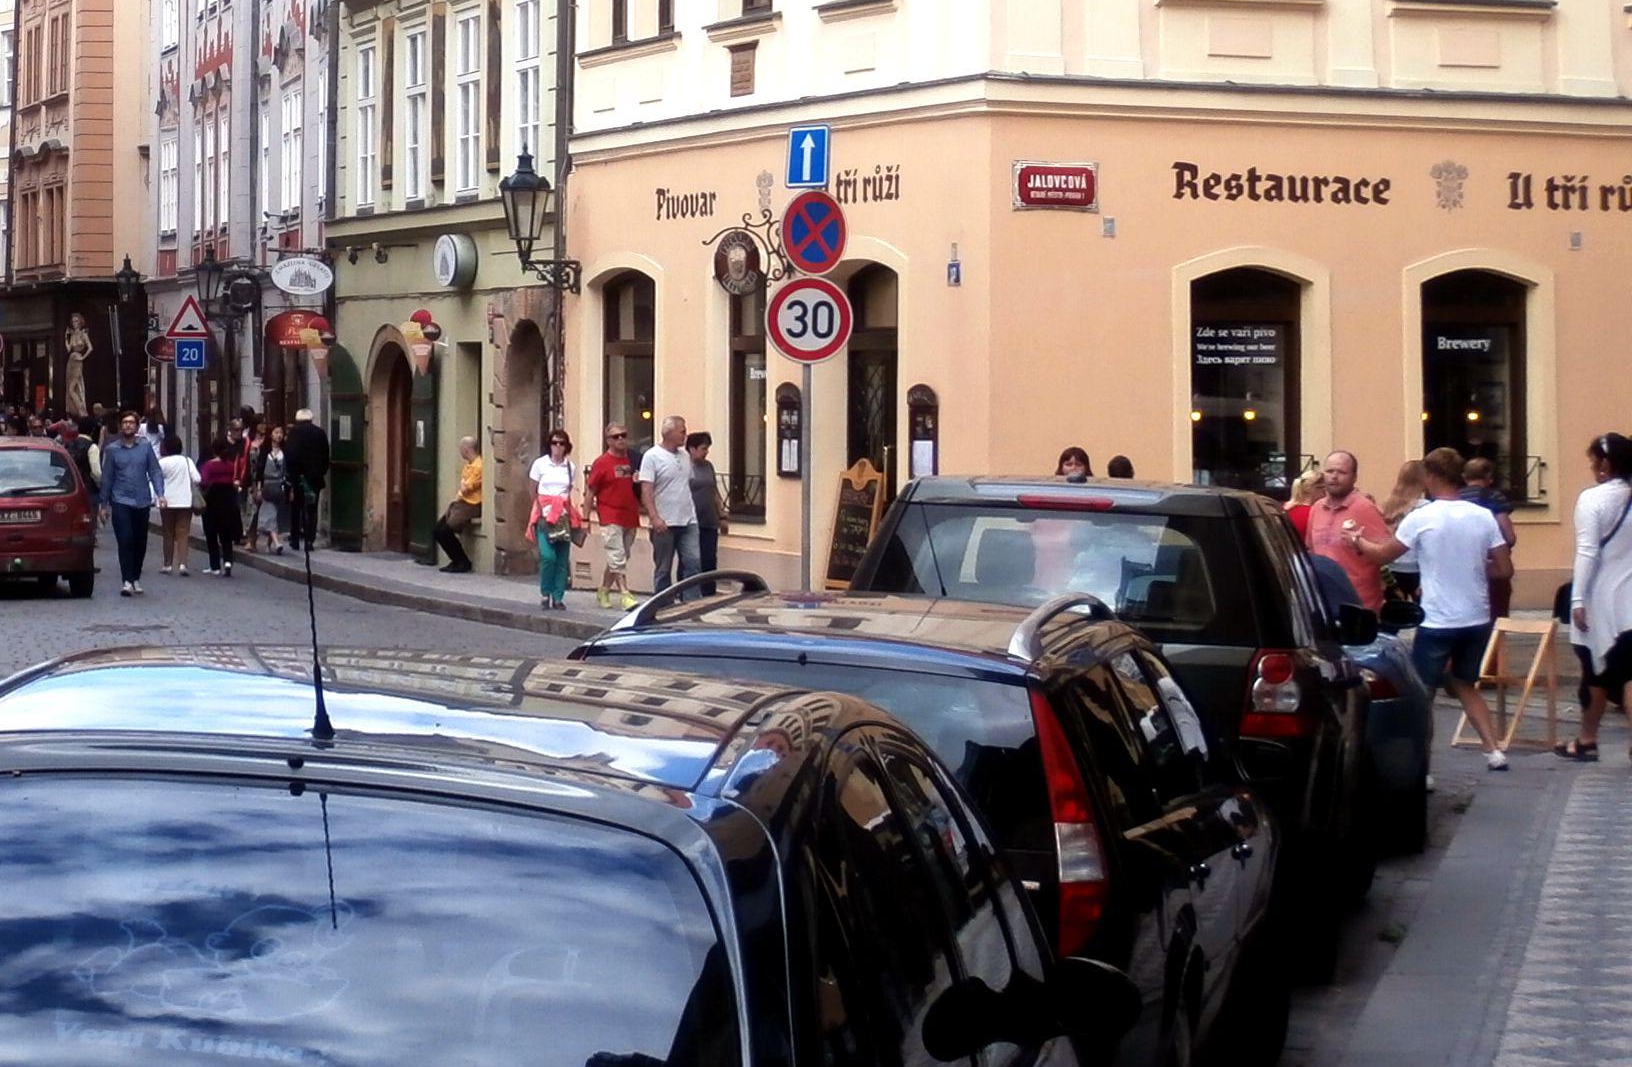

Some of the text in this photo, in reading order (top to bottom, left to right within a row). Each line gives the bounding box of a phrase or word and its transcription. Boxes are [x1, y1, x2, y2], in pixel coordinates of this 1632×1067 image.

[656, 164, 900, 220] Pivovar tří růží
[1027, 173, 1087, 189] JALOVCOVÁ
[1171, 161, 1391, 205] Restaurace
[1506, 172, 1534, 210] U
[1544, 175, 1589, 211] tří
[785, 299, 834, 339] 30
[182, 348, 199, 361] 20
[1437, 337, 1491, 352] Brewery
